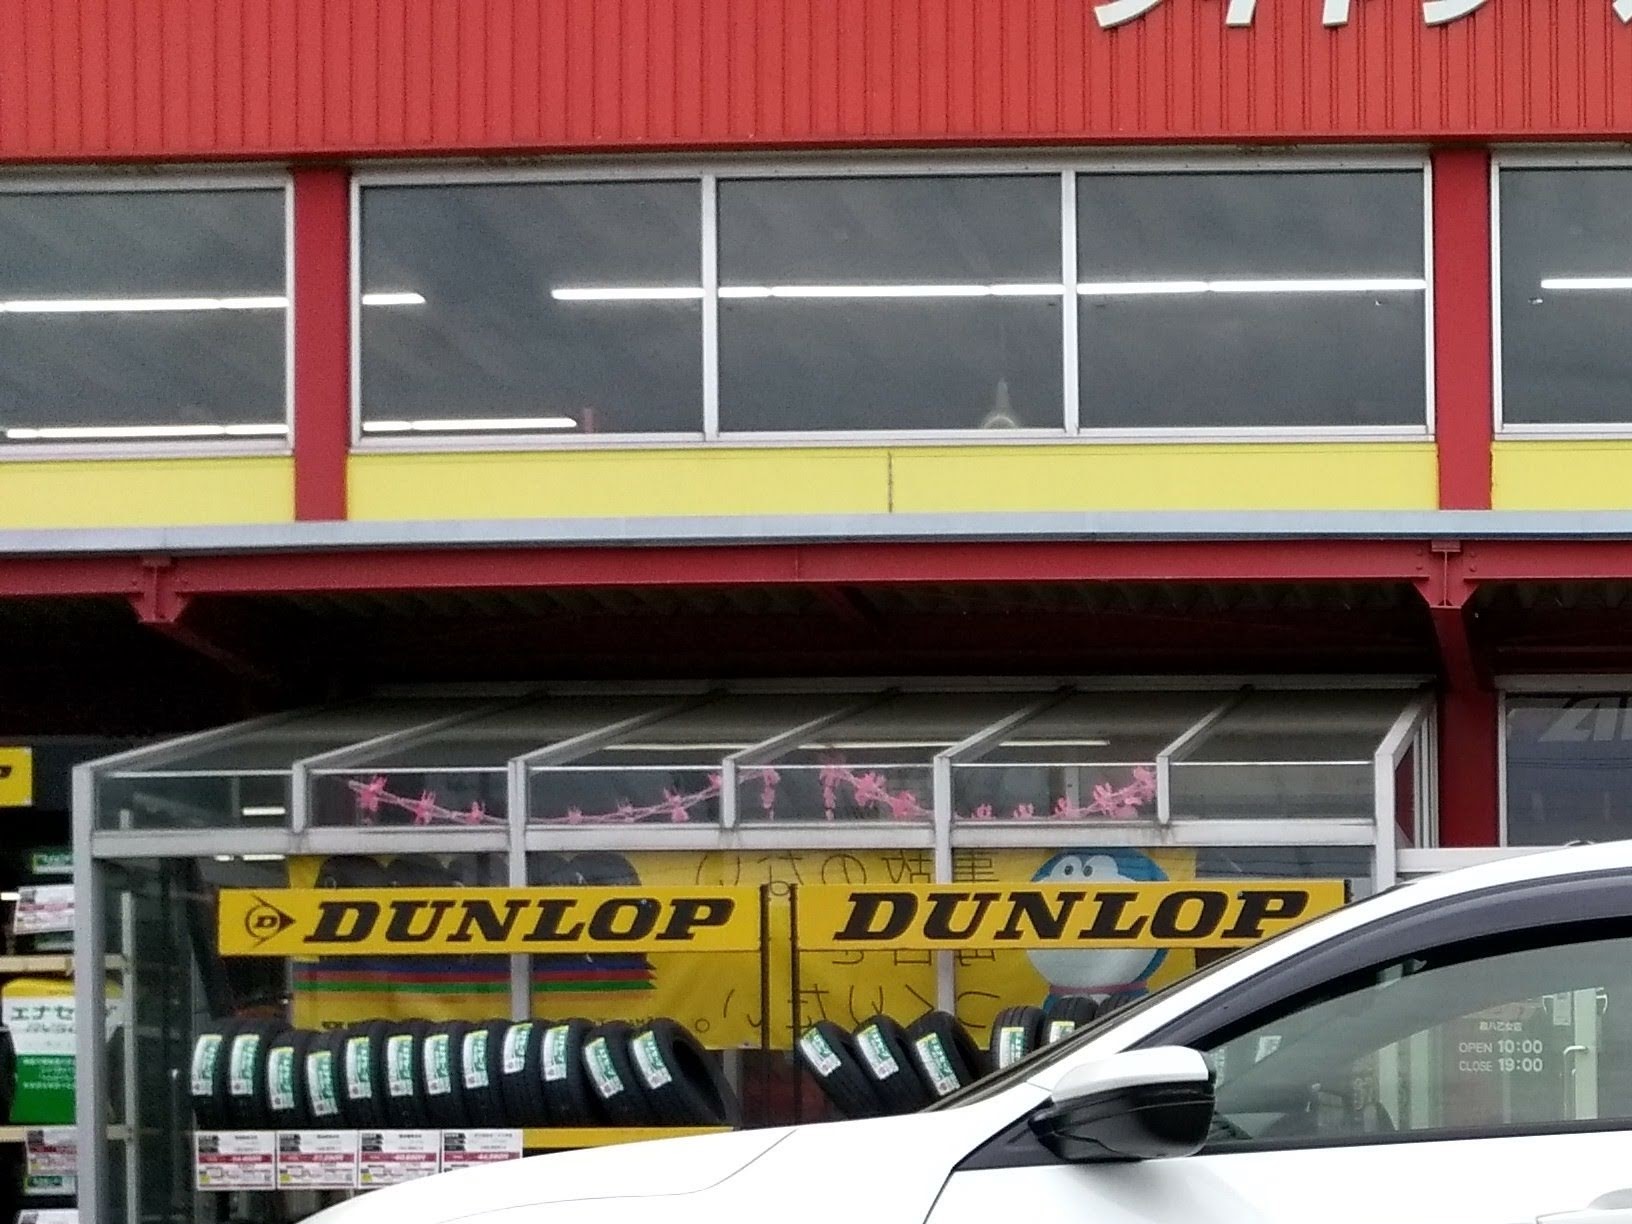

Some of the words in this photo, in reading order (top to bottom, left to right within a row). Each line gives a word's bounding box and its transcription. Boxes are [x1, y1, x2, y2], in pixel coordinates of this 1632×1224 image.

[303, 897, 736, 944] DUNLOP
[832, 890, 1311, 942] DUNLOP
[1459, 1042, 1493, 1054] OPEN
[1498, 1039, 1543, 1054] 10:00
[1459, 1060, 1493, 1072] CLOSE
[1498, 1057, 1543, 1073] 19:00
